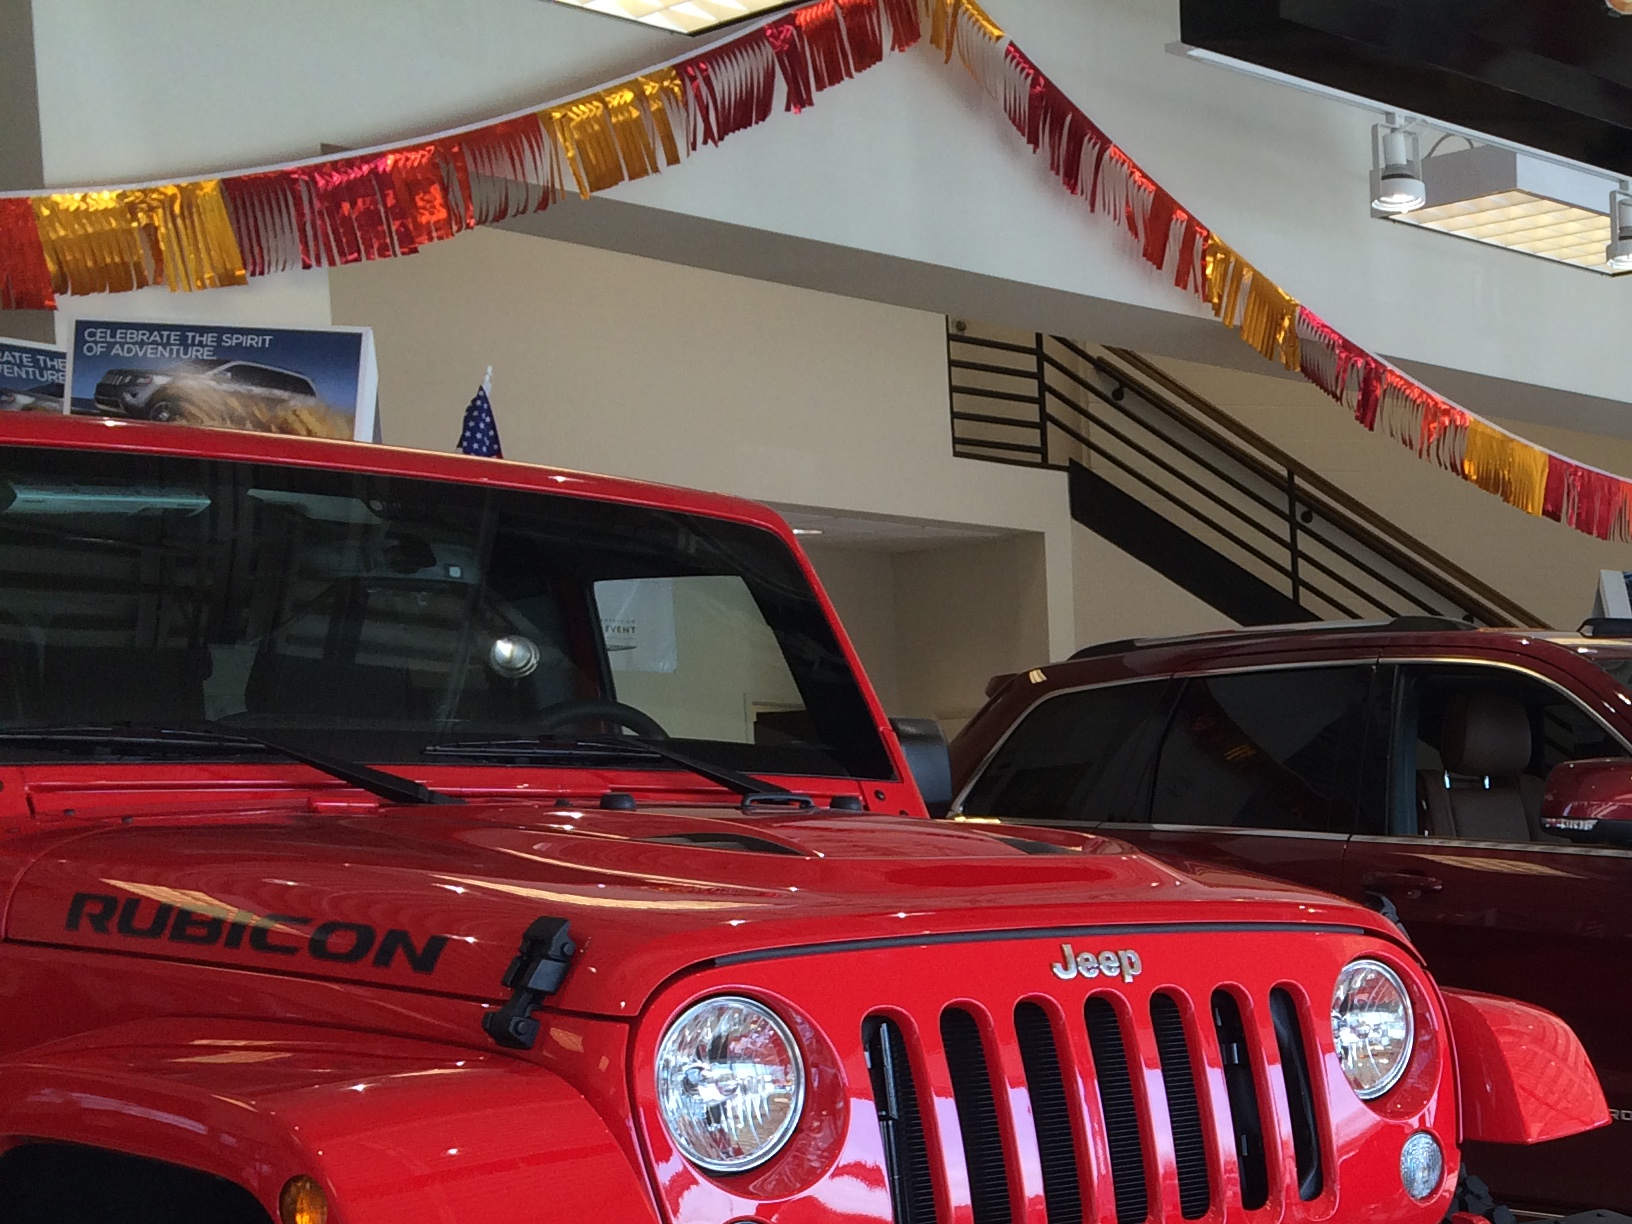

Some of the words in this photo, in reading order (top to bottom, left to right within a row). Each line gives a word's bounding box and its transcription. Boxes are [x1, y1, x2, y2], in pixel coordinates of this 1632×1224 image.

[84, 328, 180, 344] CELEBRATE
[185, 332, 218, 346] THE
[221, 334, 273, 348] SPIRIT
[83, 343, 107, 356] OF
[605, 625, 635, 634] EVENT
[65, 891, 449, 974] RUBICON
[1051, 943, 1142, 983] Jeep
